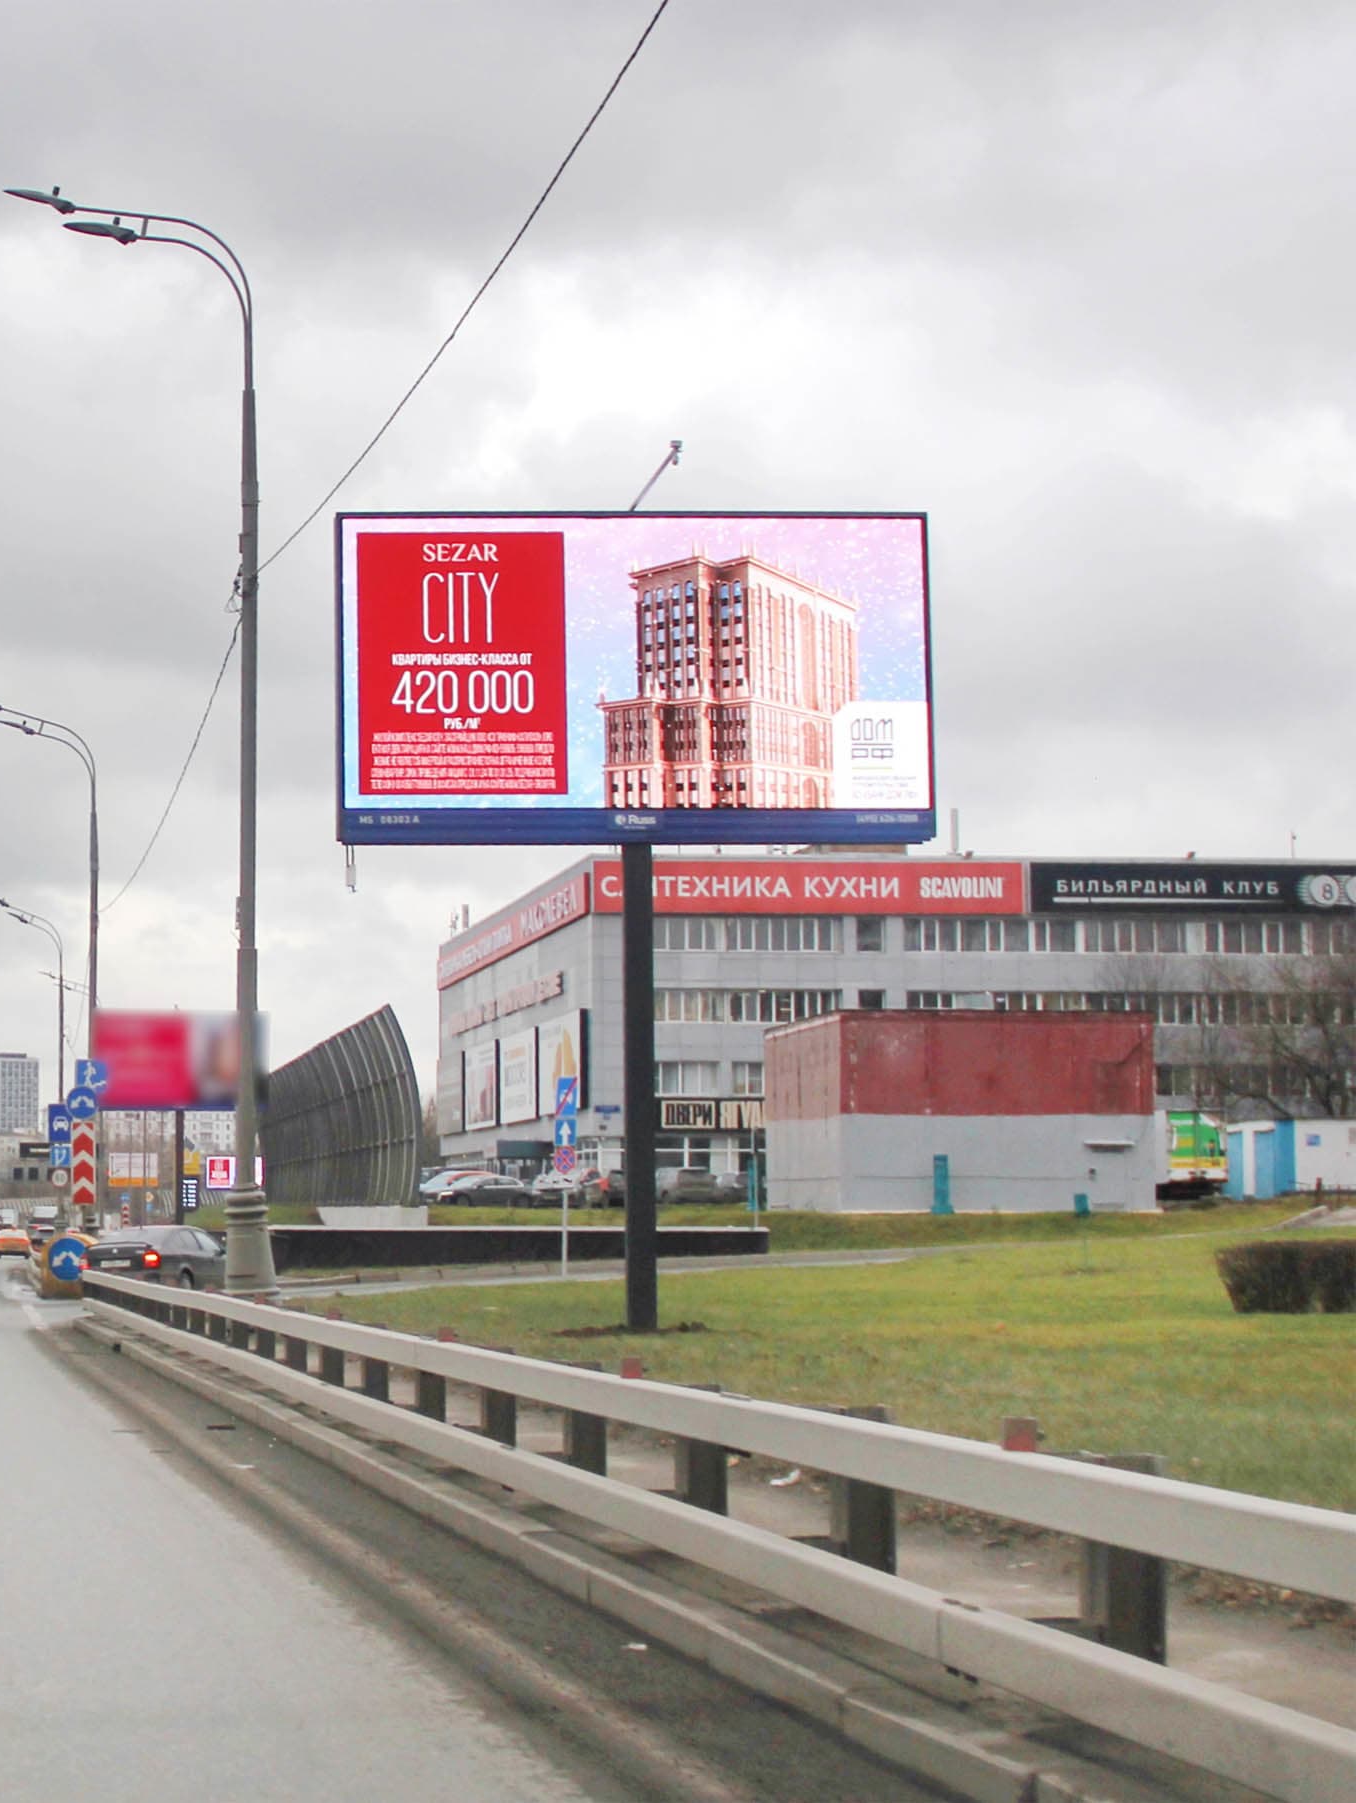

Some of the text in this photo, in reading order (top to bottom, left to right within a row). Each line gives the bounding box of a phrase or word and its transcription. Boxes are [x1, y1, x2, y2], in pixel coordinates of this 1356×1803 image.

[422, 543, 499, 563] SEZAR
[422, 572, 499, 643] CITY
[391, 653, 532, 665] КВАРТИРЫ БИЗНЕС-КЛАССА ОТ
[391, 670, 534, 714] 420 000
[600, 876, 900, 898] СТЕХНИКА КУХНИ
[920, 876, 1004, 898] SCAVOLINI
[1056, 878, 1279, 895] БИЛЬЯРДНЫЙ КЛУБ
[1322, 883, 1333, 900] 8
[664, 1101, 764, 1128] ДВЕРИ ЯГУА
